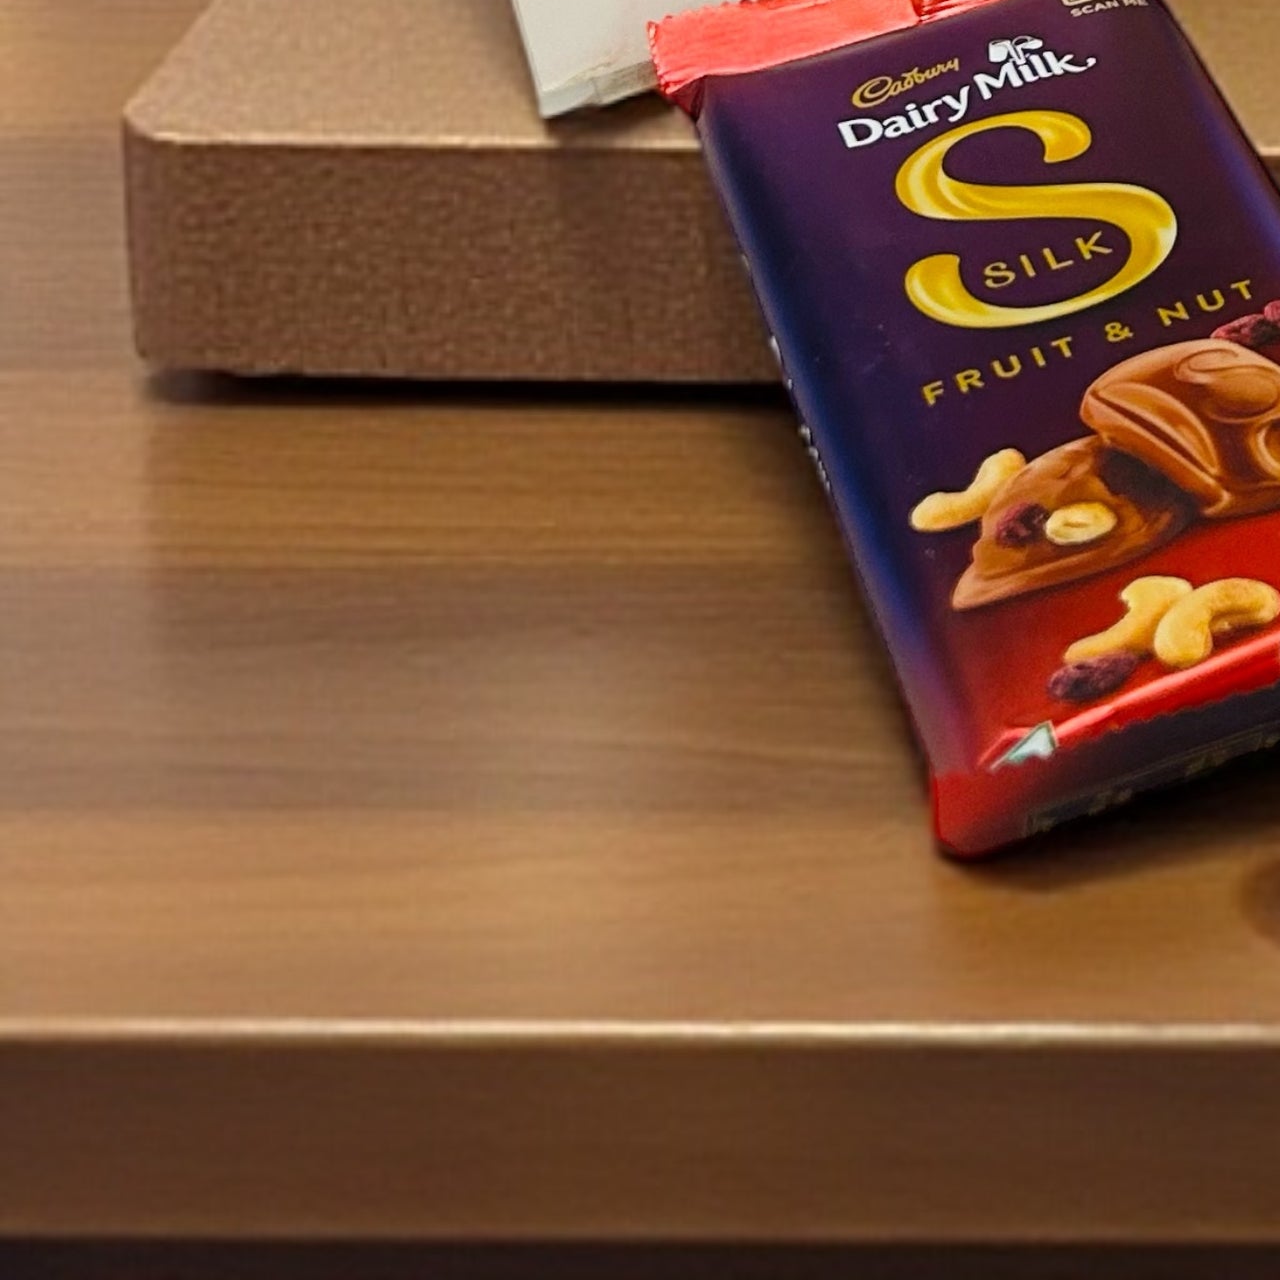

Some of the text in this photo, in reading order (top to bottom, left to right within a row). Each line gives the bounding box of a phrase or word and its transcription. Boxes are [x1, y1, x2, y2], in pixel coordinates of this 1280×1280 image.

[1070, 0, 1120, 17] SCAN
[837, 48, 1097, 149] Dairy Milk
[851, 57, 960, 109] Cadbury
[983, 231, 1113, 289] SILK
[922, 278, 1255, 406] FRUIT & NUT
